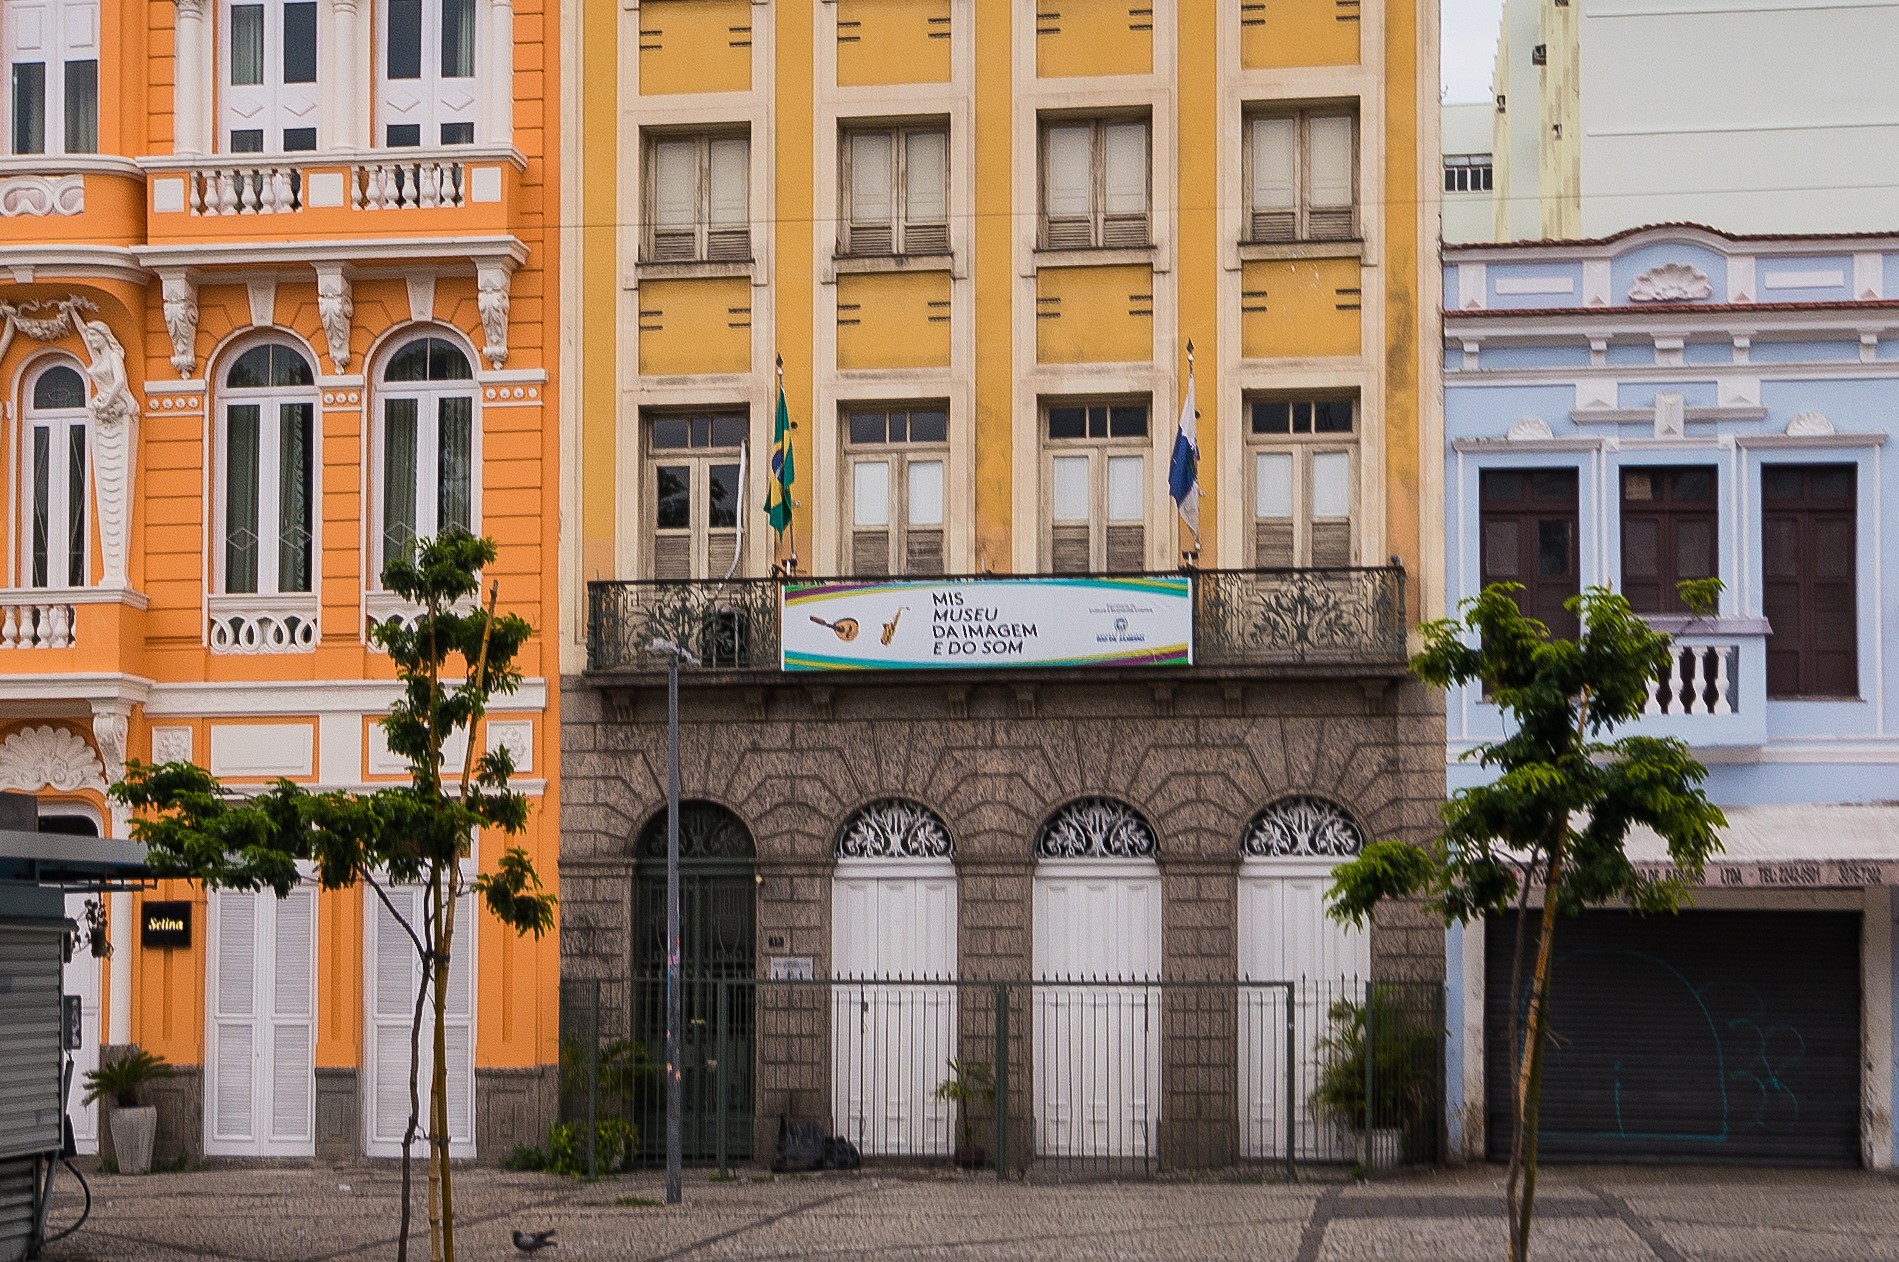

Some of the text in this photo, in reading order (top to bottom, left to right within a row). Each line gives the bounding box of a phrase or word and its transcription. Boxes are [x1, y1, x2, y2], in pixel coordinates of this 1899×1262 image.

[932, 591, 964, 606] MIS
[933, 607, 998, 623] MUSEU
[932, 623, 1038, 639] DA IMAGEM
[933, 640, 1024, 656] E DO SOM
